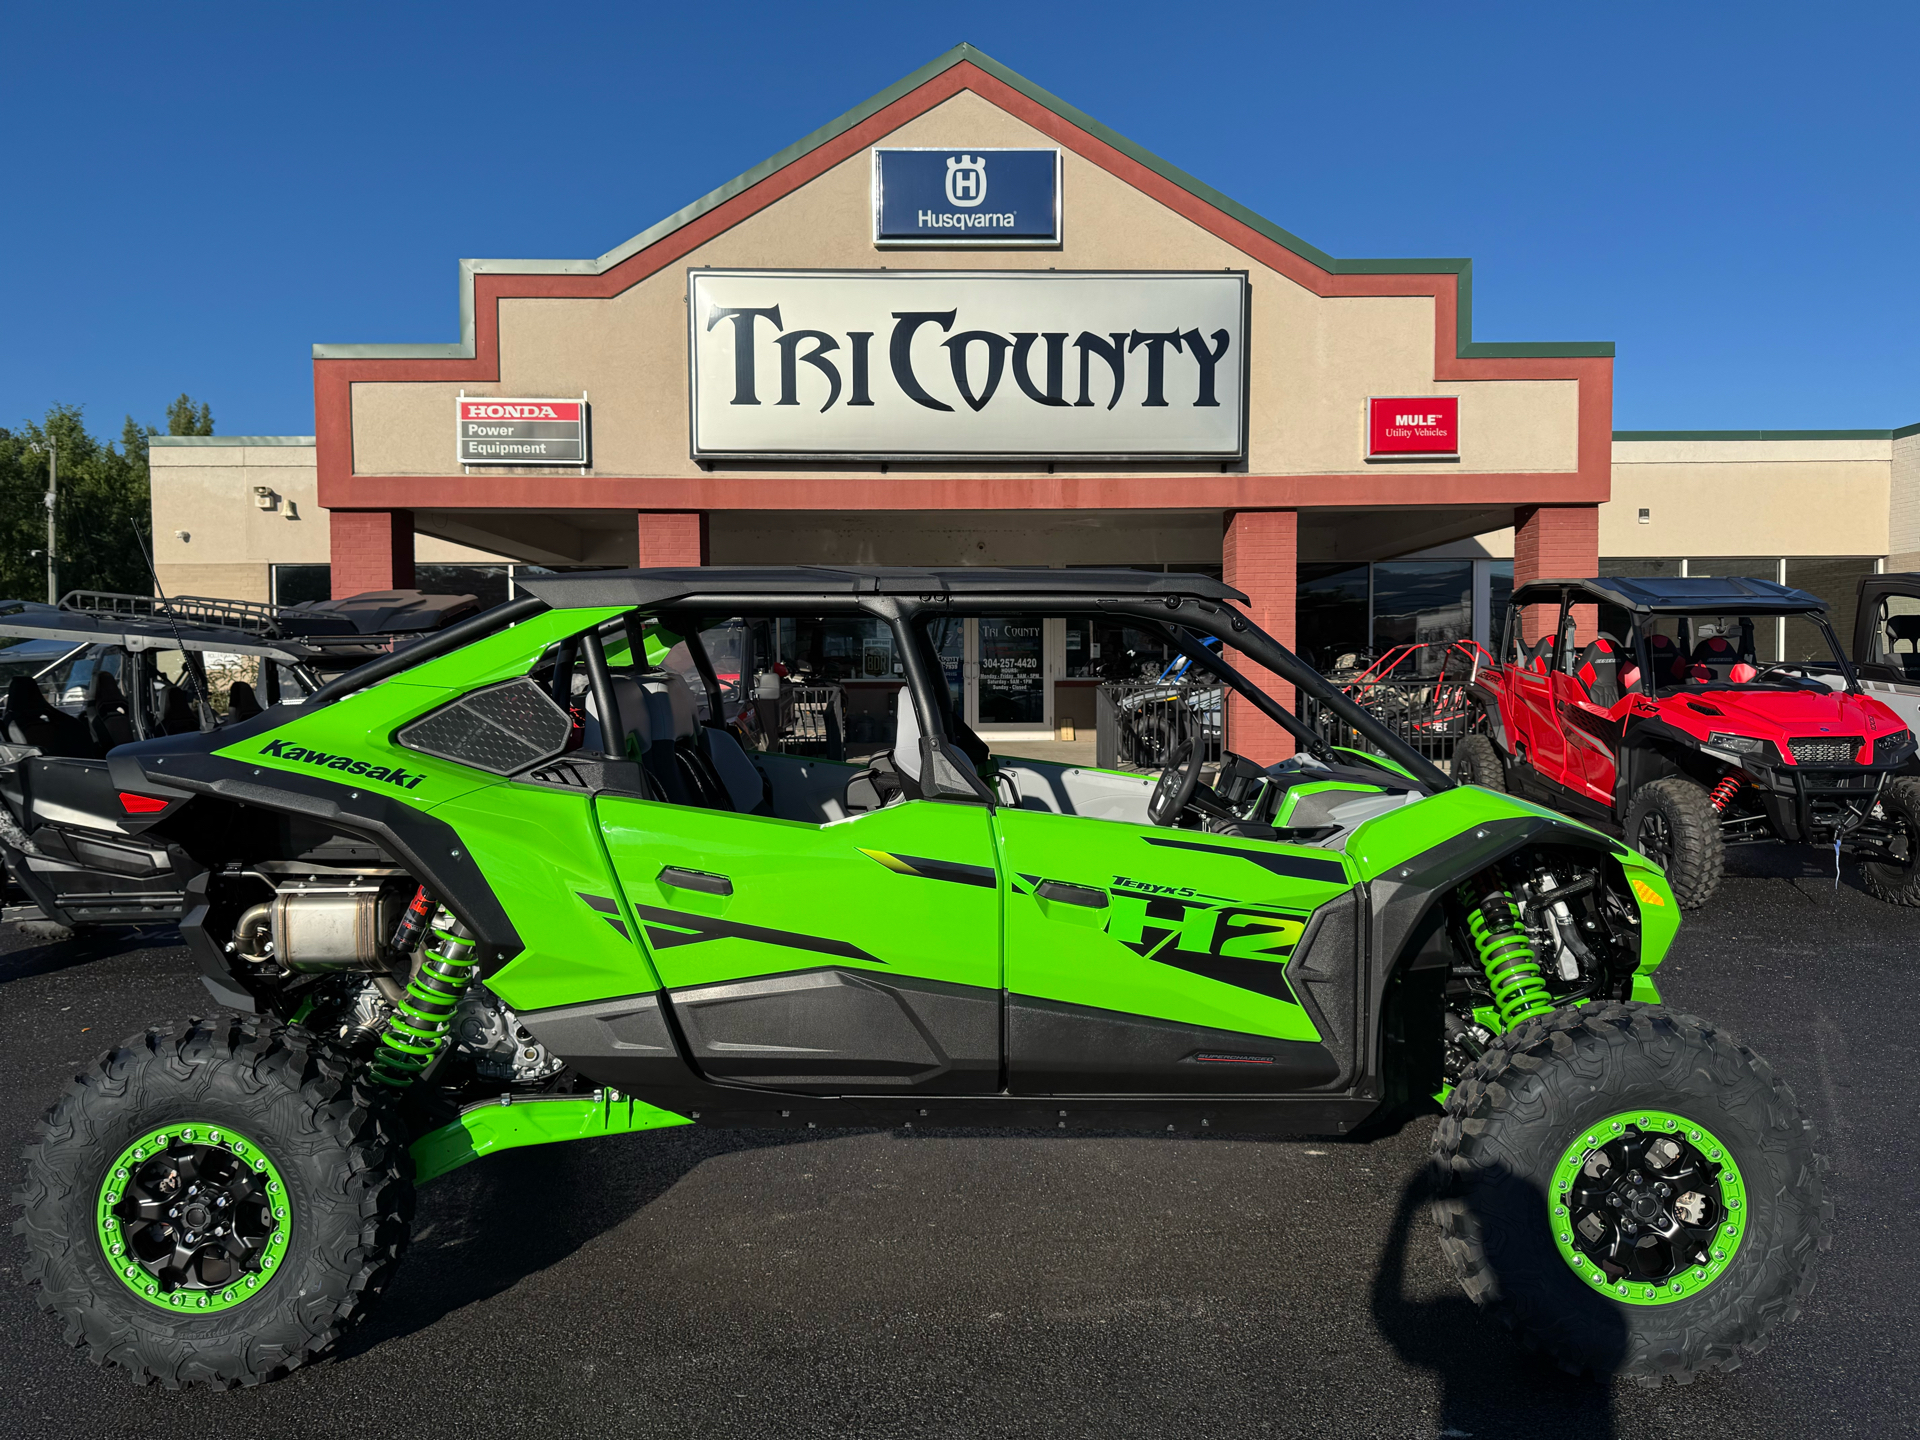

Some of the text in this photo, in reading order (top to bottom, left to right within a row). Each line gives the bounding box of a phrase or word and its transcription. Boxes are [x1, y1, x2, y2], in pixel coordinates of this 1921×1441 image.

[918, 210, 1014, 231] Husqvarna
[468, 405, 558, 418] HONDA
[468, 424, 514, 436] Power
[1385, 427, 1448, 439] Utility Vehicles
[469, 441, 546, 455] Equipment
[982, 658, 1037, 668] 304-257-4420
[1632, 700, 1661, 713] XP
[258, 739, 428, 790] Kawasaki
[1107, 894, 1306, 964] H2
[1198, 1053, 1274, 1062] SUPERCHARGED
